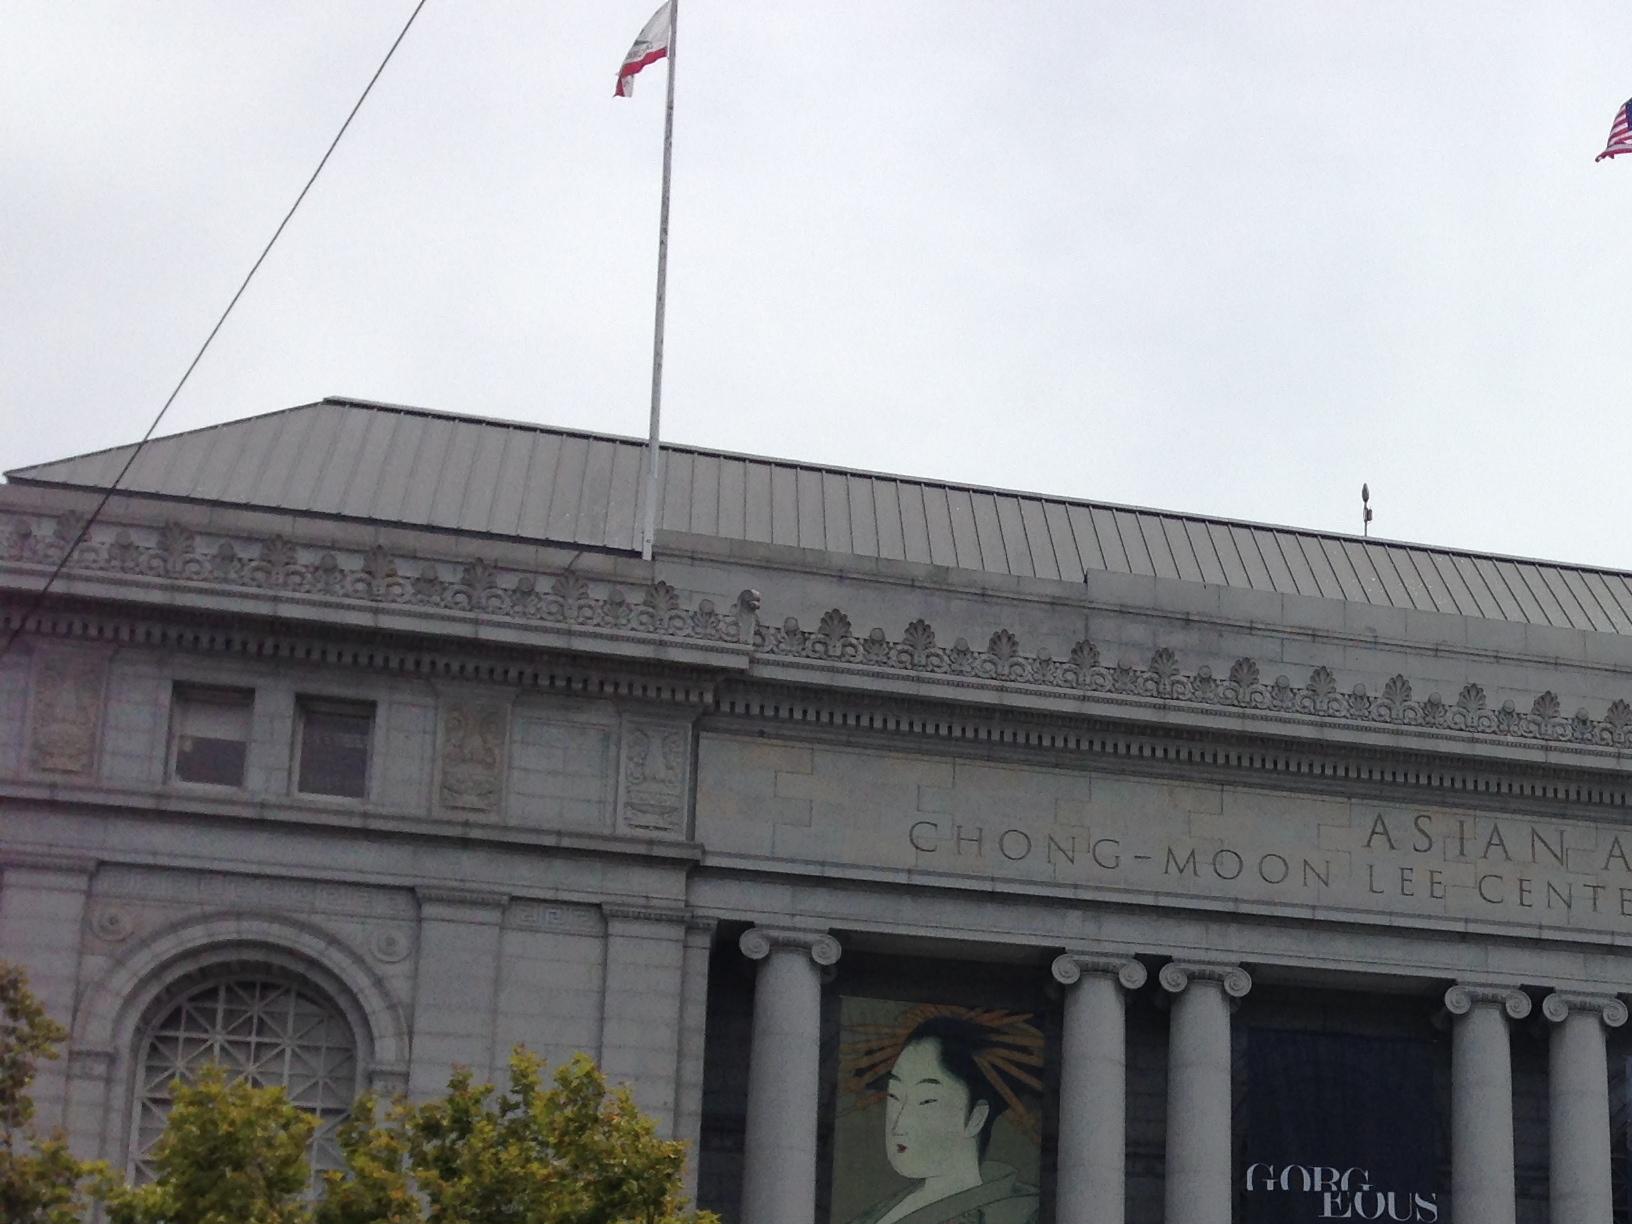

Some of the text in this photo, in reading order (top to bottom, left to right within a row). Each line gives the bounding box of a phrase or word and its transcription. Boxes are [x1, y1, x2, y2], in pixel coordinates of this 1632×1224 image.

[909, 820, 1330, 888] CHONG-MOON
[1367, 865, 1444, 899] LEE
[1365, 812, 1569, 868] ASIAN
